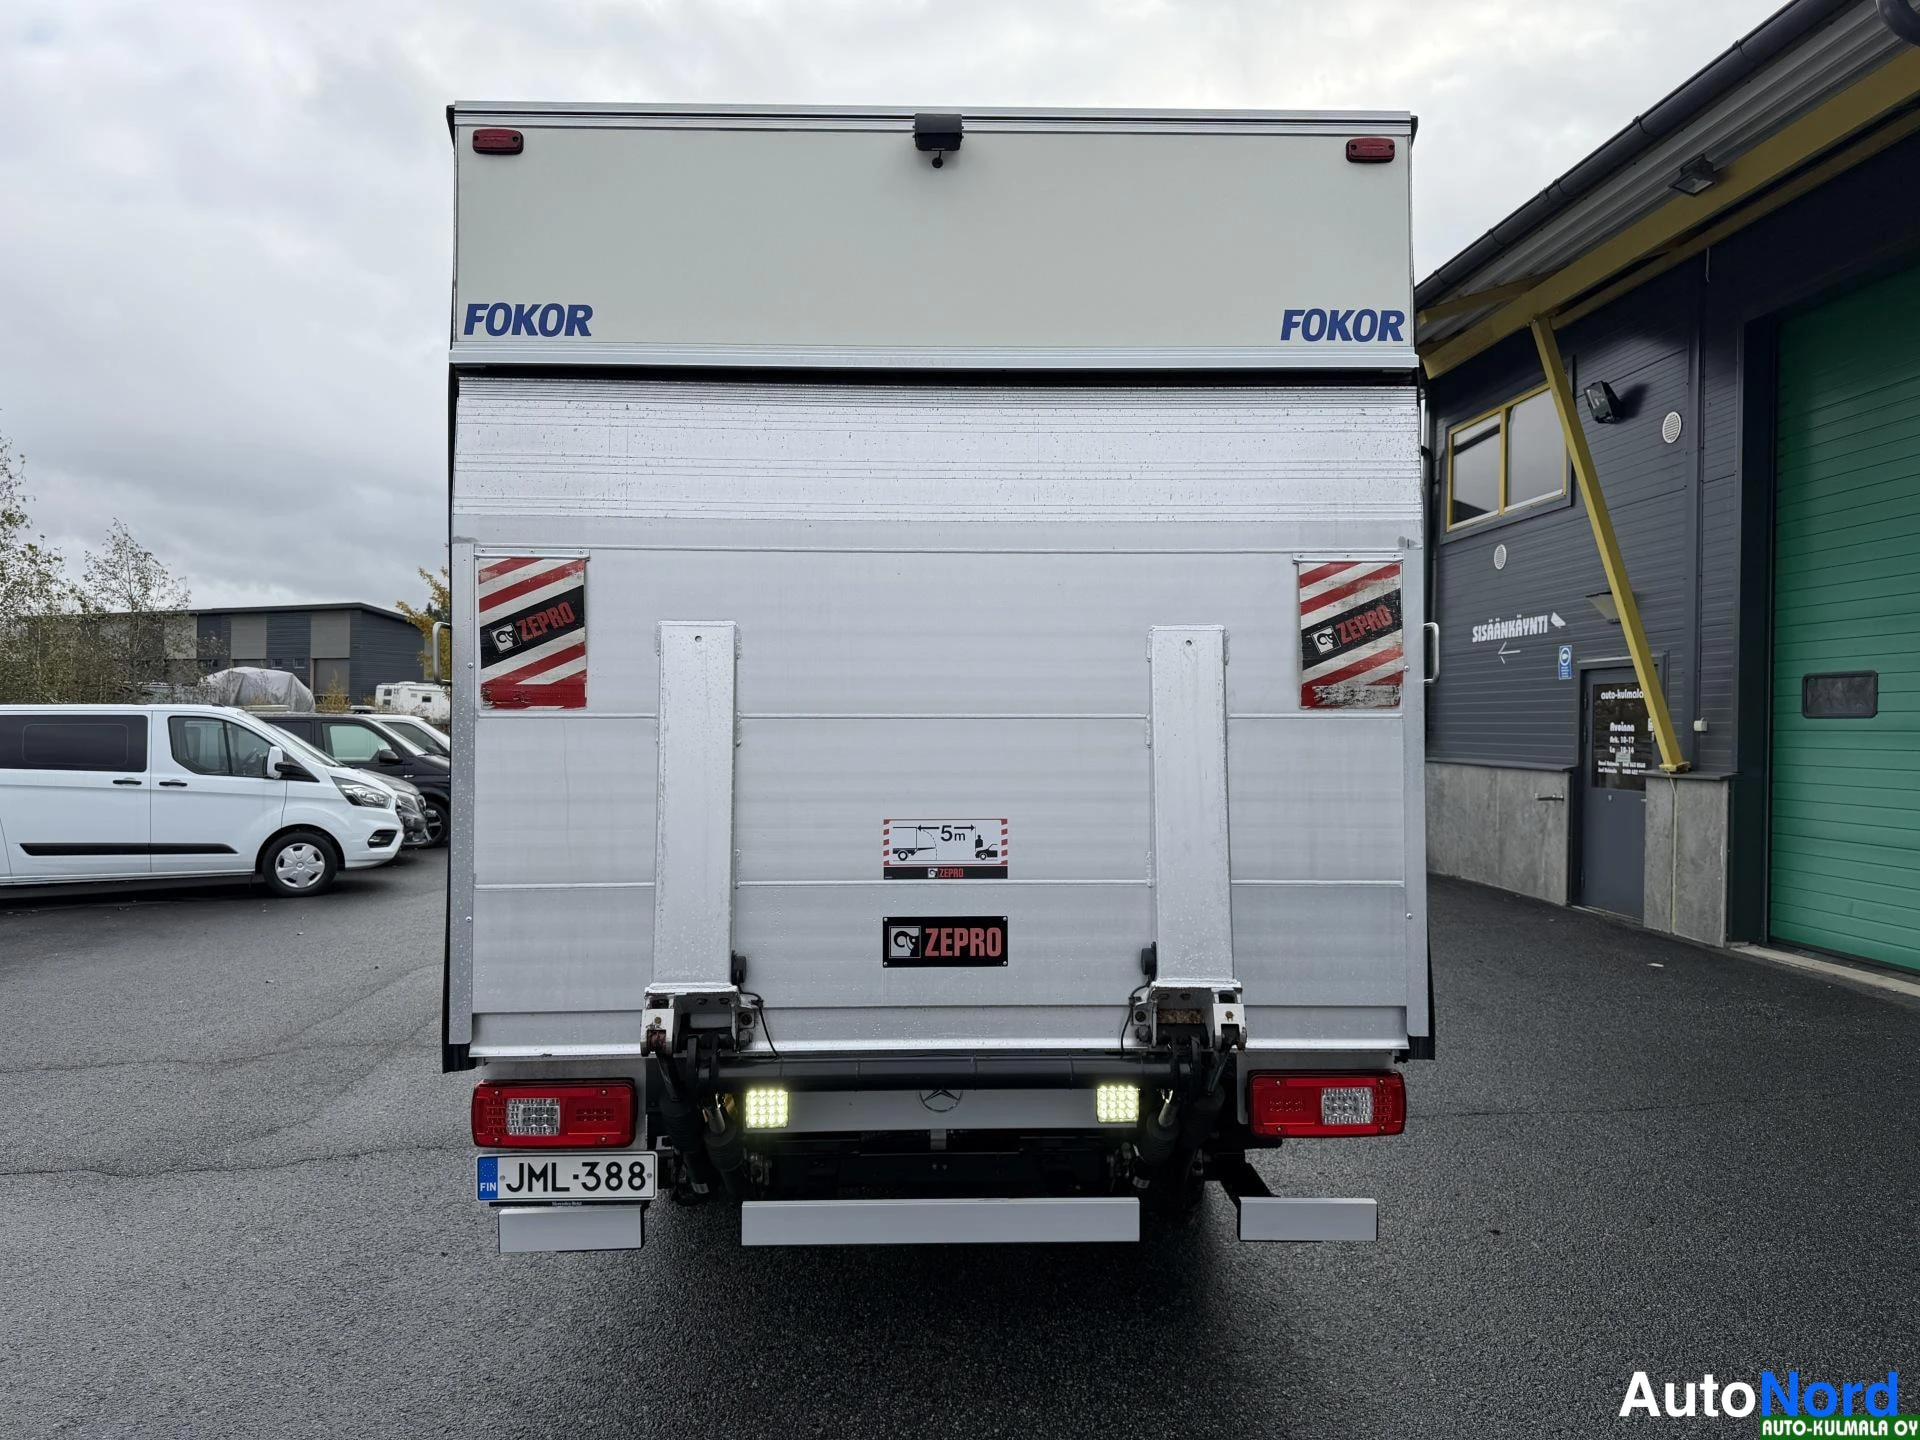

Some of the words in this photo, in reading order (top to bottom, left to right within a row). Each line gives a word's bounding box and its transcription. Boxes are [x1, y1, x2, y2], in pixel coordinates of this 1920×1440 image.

[463, 302, 593, 337] FOKOR
[1280, 308, 1405, 342] FOKOR
[515, 601, 577, 642] ZEPRO
[1335, 604, 1393, 645] ZEPRO
[1472, 613, 1548, 643] SISÄÄNKÄYNTI
[939, 868, 964, 878] ZEPRO
[924, 927, 1002, 957] ZEPRO
[480, 1182, 497, 1192] FIN
[505, 1161, 646, 1193] JML-388
